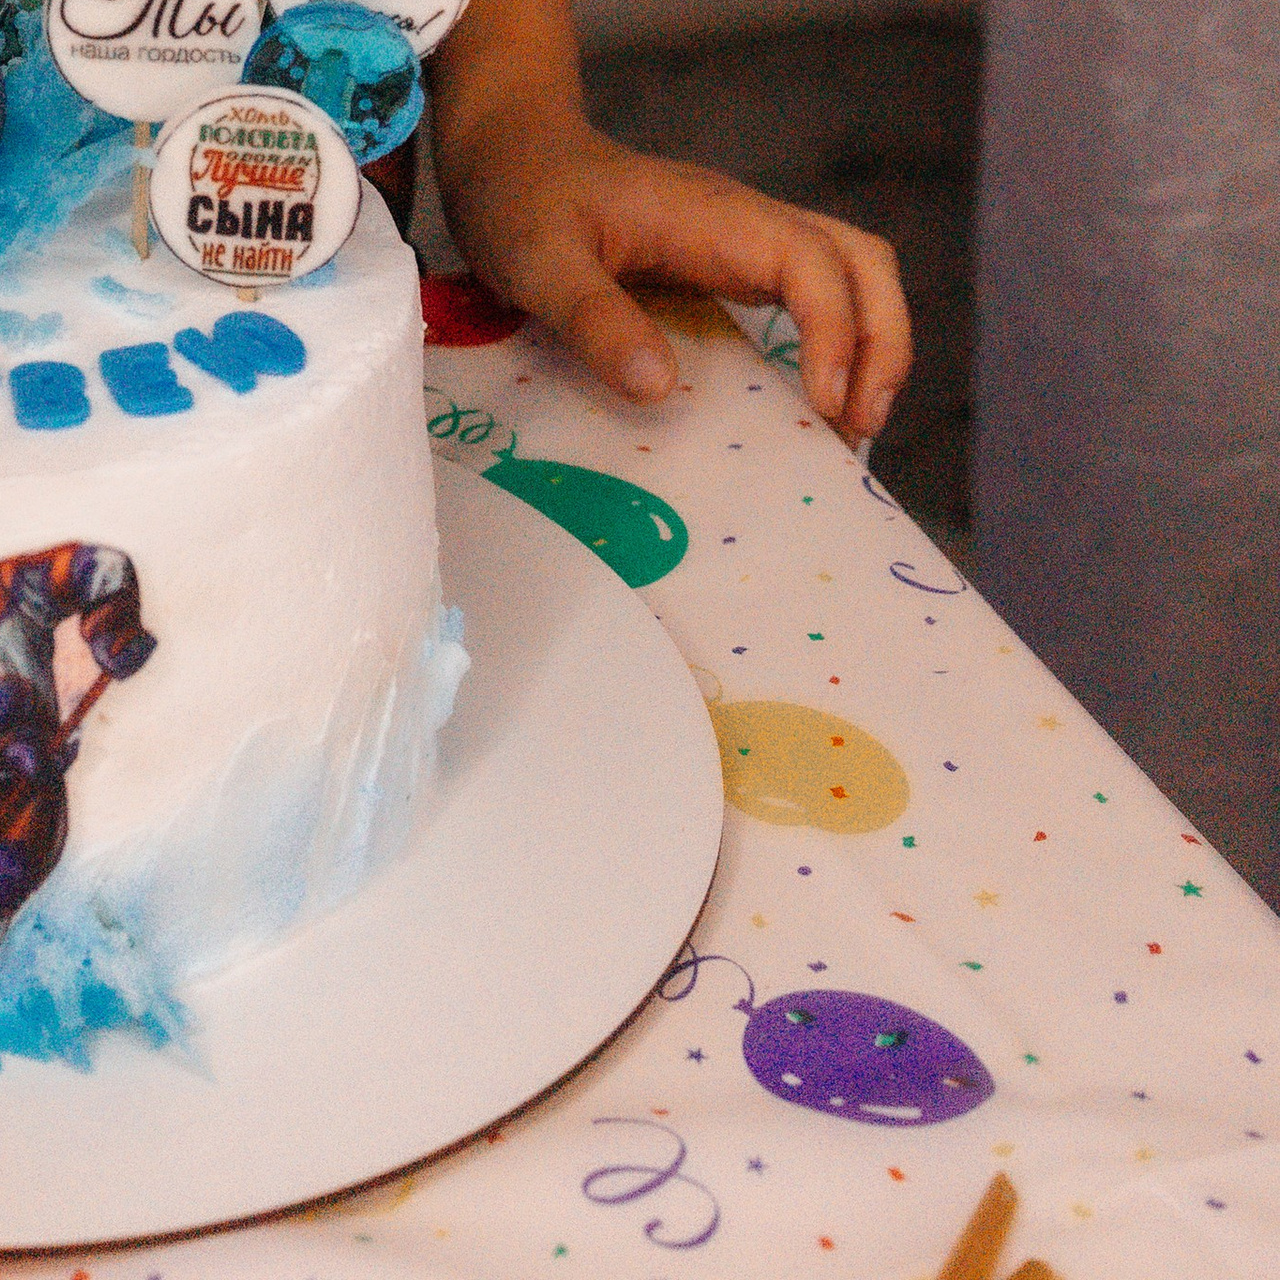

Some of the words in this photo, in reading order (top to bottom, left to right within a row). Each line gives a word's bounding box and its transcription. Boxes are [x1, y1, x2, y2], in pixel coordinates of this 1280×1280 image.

[70, 44, 130, 61] наша
[138, 46, 242, 65] гордость
[199, 124, 320, 151] ПОЛСВЕТА
[186, 194, 315, 242] СЫНА
